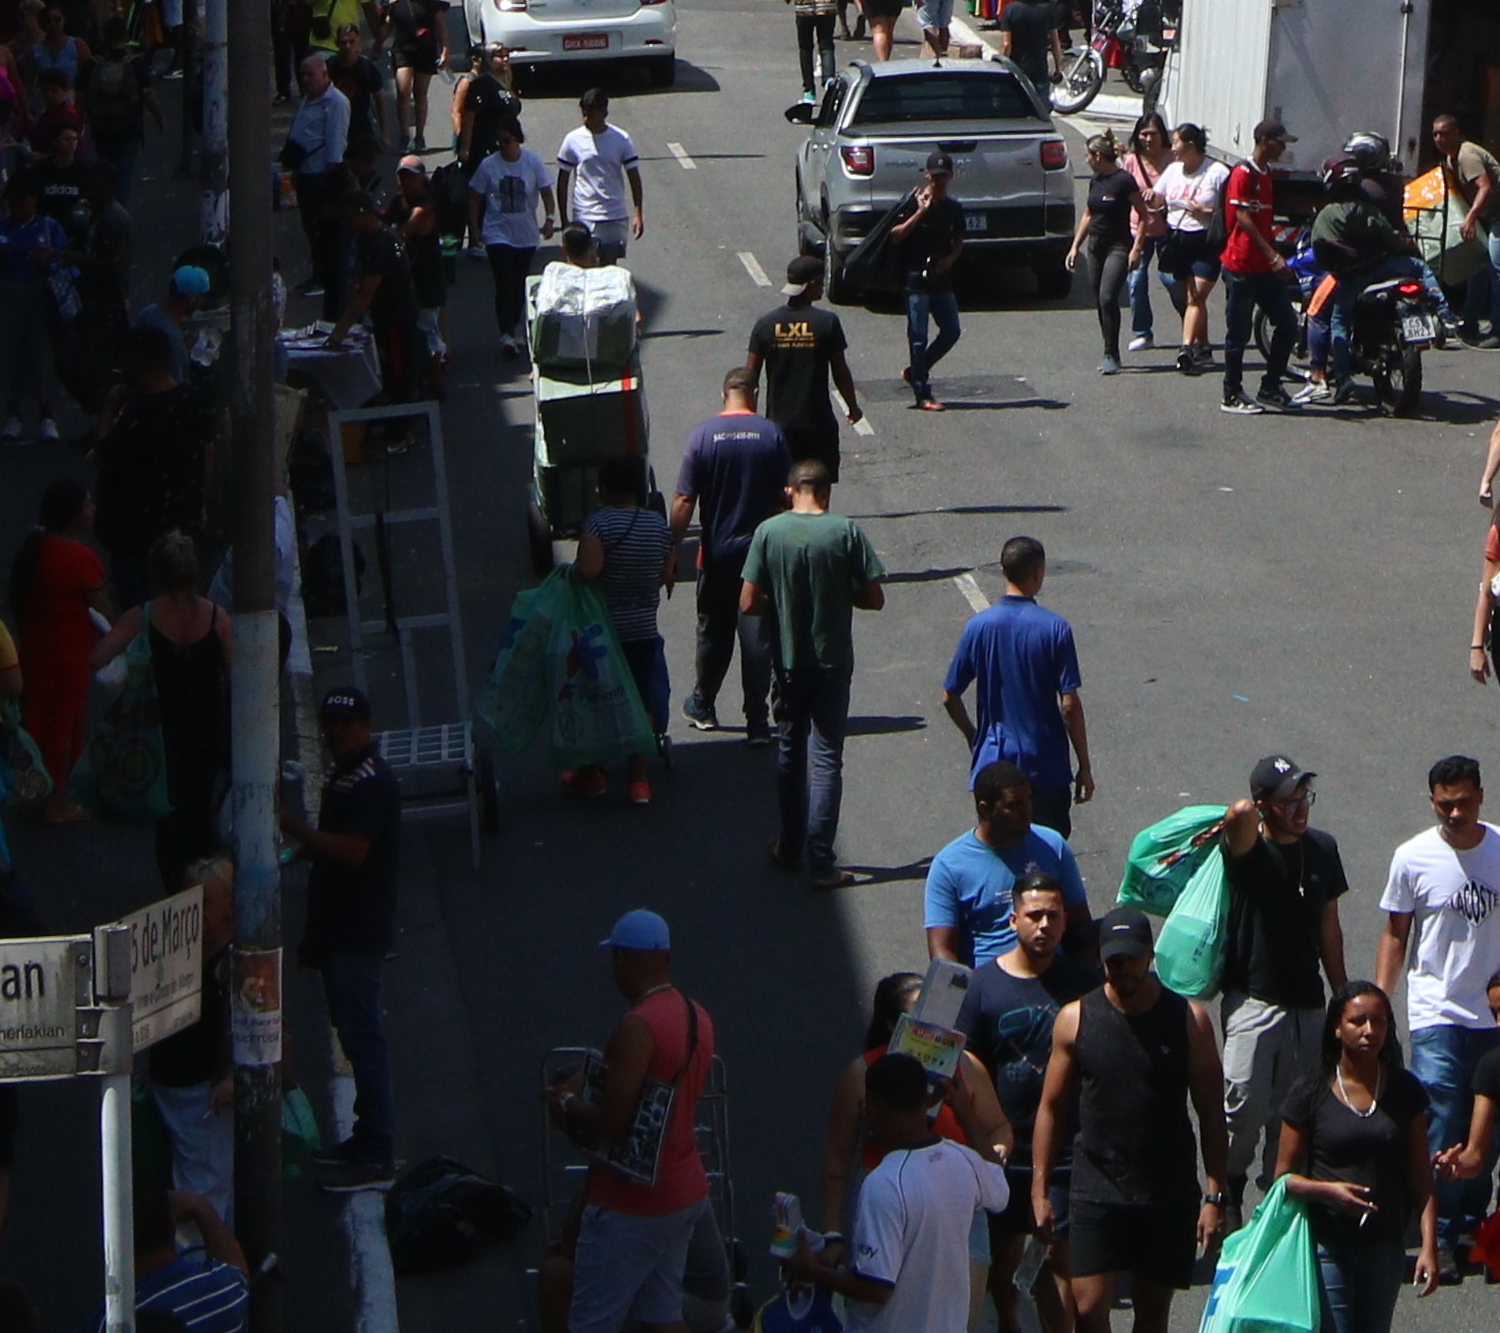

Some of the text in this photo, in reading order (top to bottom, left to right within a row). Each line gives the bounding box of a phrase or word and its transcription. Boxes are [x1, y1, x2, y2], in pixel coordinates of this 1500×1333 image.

[775, 321, 813, 338] LXL
[142, 912, 158, 967] de
[162, 902, 200, 960] Março
